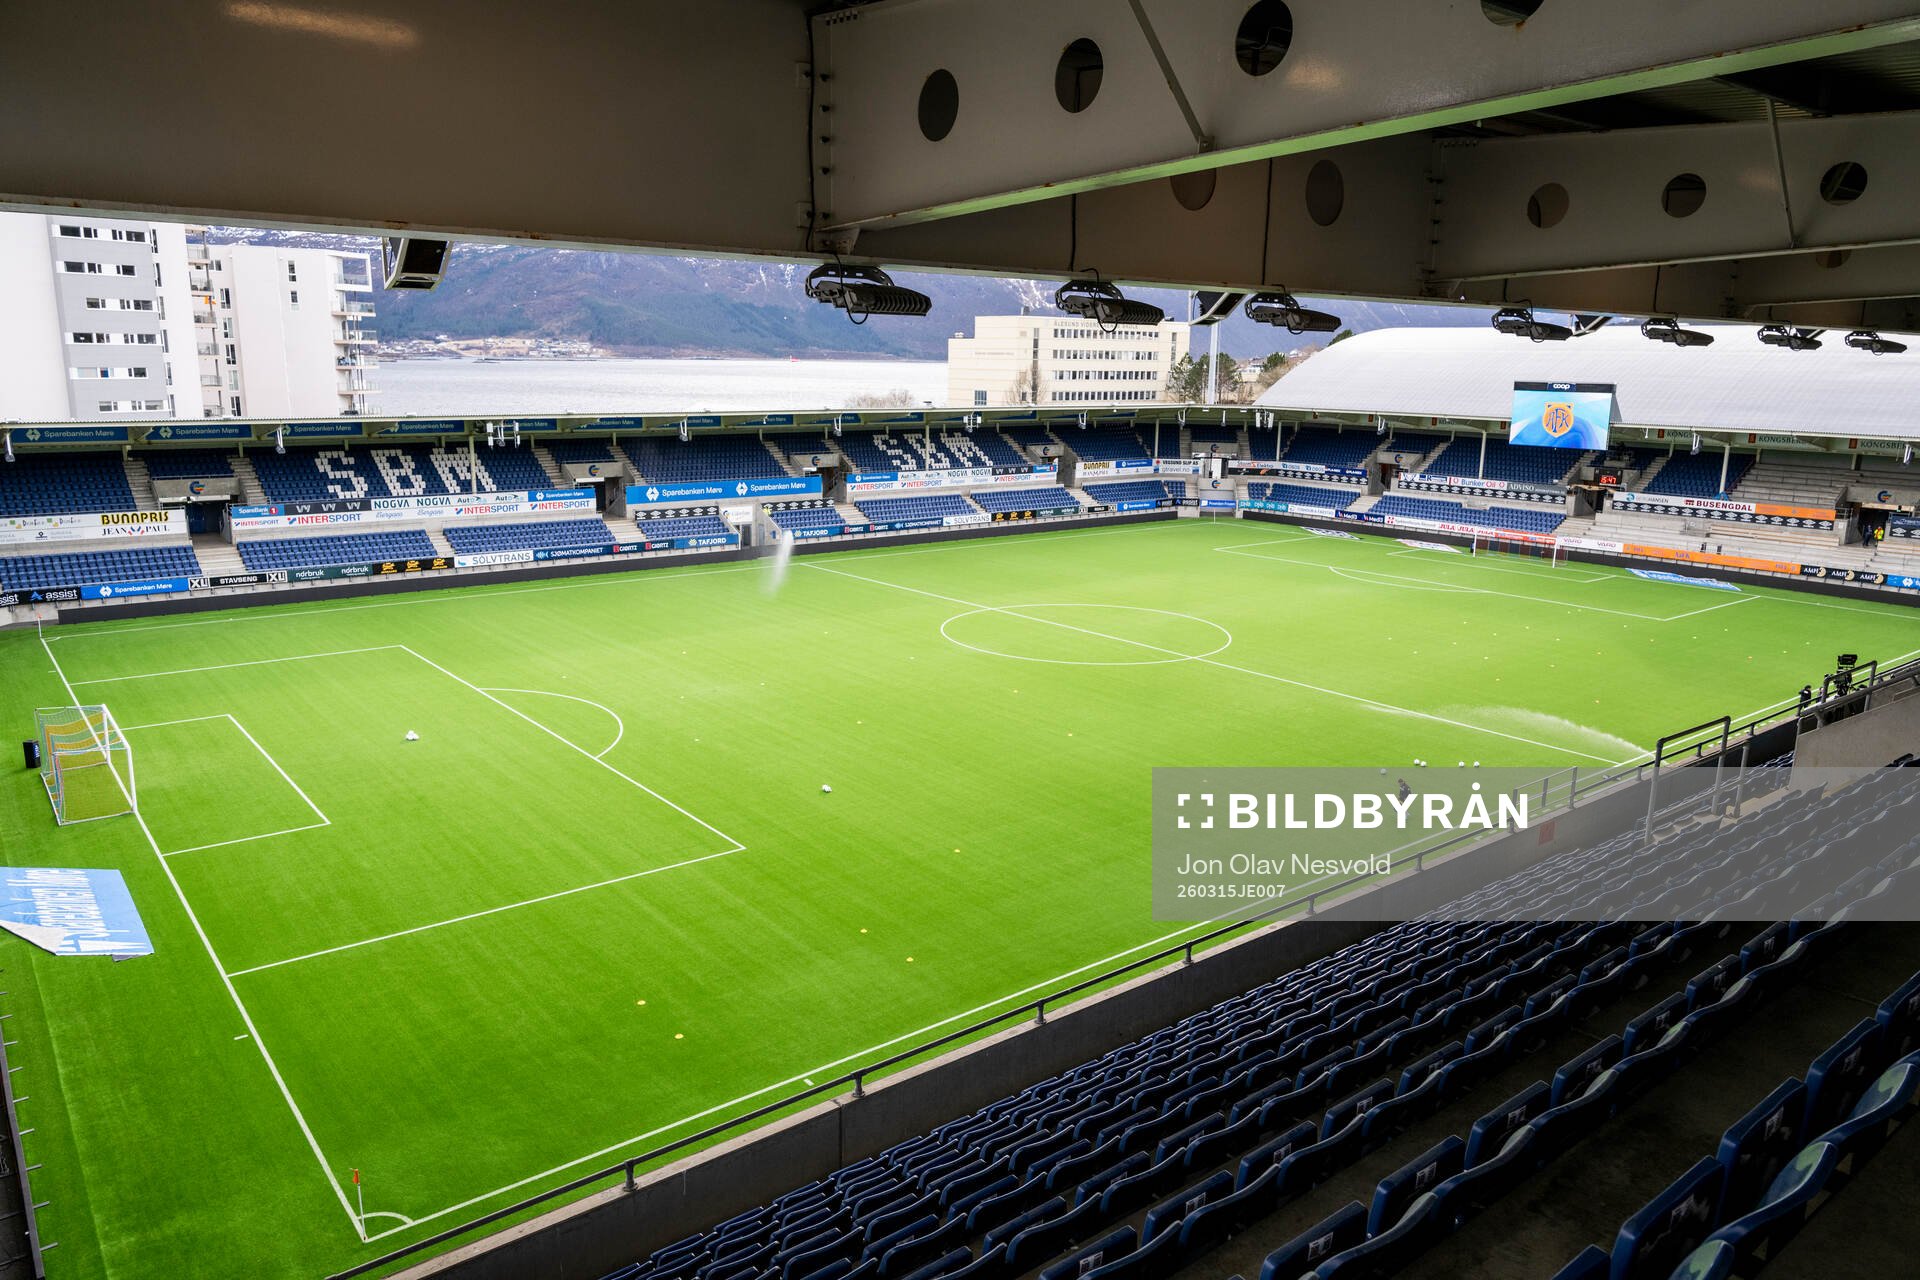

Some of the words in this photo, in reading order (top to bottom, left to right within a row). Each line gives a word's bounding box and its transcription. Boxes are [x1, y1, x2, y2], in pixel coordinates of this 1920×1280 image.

[293, 424, 334, 433] Sparebanken
[335, 424, 352, 432] Møre
[439, 422, 455, 430] Møre
[44, 430, 94, 439] Sparebanken
[175, 427, 220, 436] Sparebanken
[221, 427, 240, 435] Møre
[750, 483, 790, 493] Sparebanken
[790, 482, 806, 490] Møre
[856, 482, 894, 491] INTERSPORT
[906, 479, 943, 488] INTERSPORT
[1461, 478, 1485, 488] Bunker
[662, 488, 705, 498] Sparebanken
[706, 486, 723, 495] Møre
[374, 498, 410, 509] NOGVA
[416, 496, 451, 507] NOGVA
[538, 500, 590, 510] INTERSPORT
[1696, 499, 1753, 512] BUSENGDAL
[464, 504, 520, 515] INTERSPORT
[101, 511, 169, 526] BUNNPRIS
[240, 519, 279, 527] INTERSPORT
[297, 513, 362, 525] INTERSPORT
[102, 525, 127, 536] JEAN
[145, 524, 170, 533] PAUL
[803, 529, 829, 537] TAFJORD
[698, 537, 727, 545] TAFJORD
[220, 576, 258, 585] STAVSENG
[45, 589, 78, 599] assist
[115, 584, 156, 594] Sparebanken
